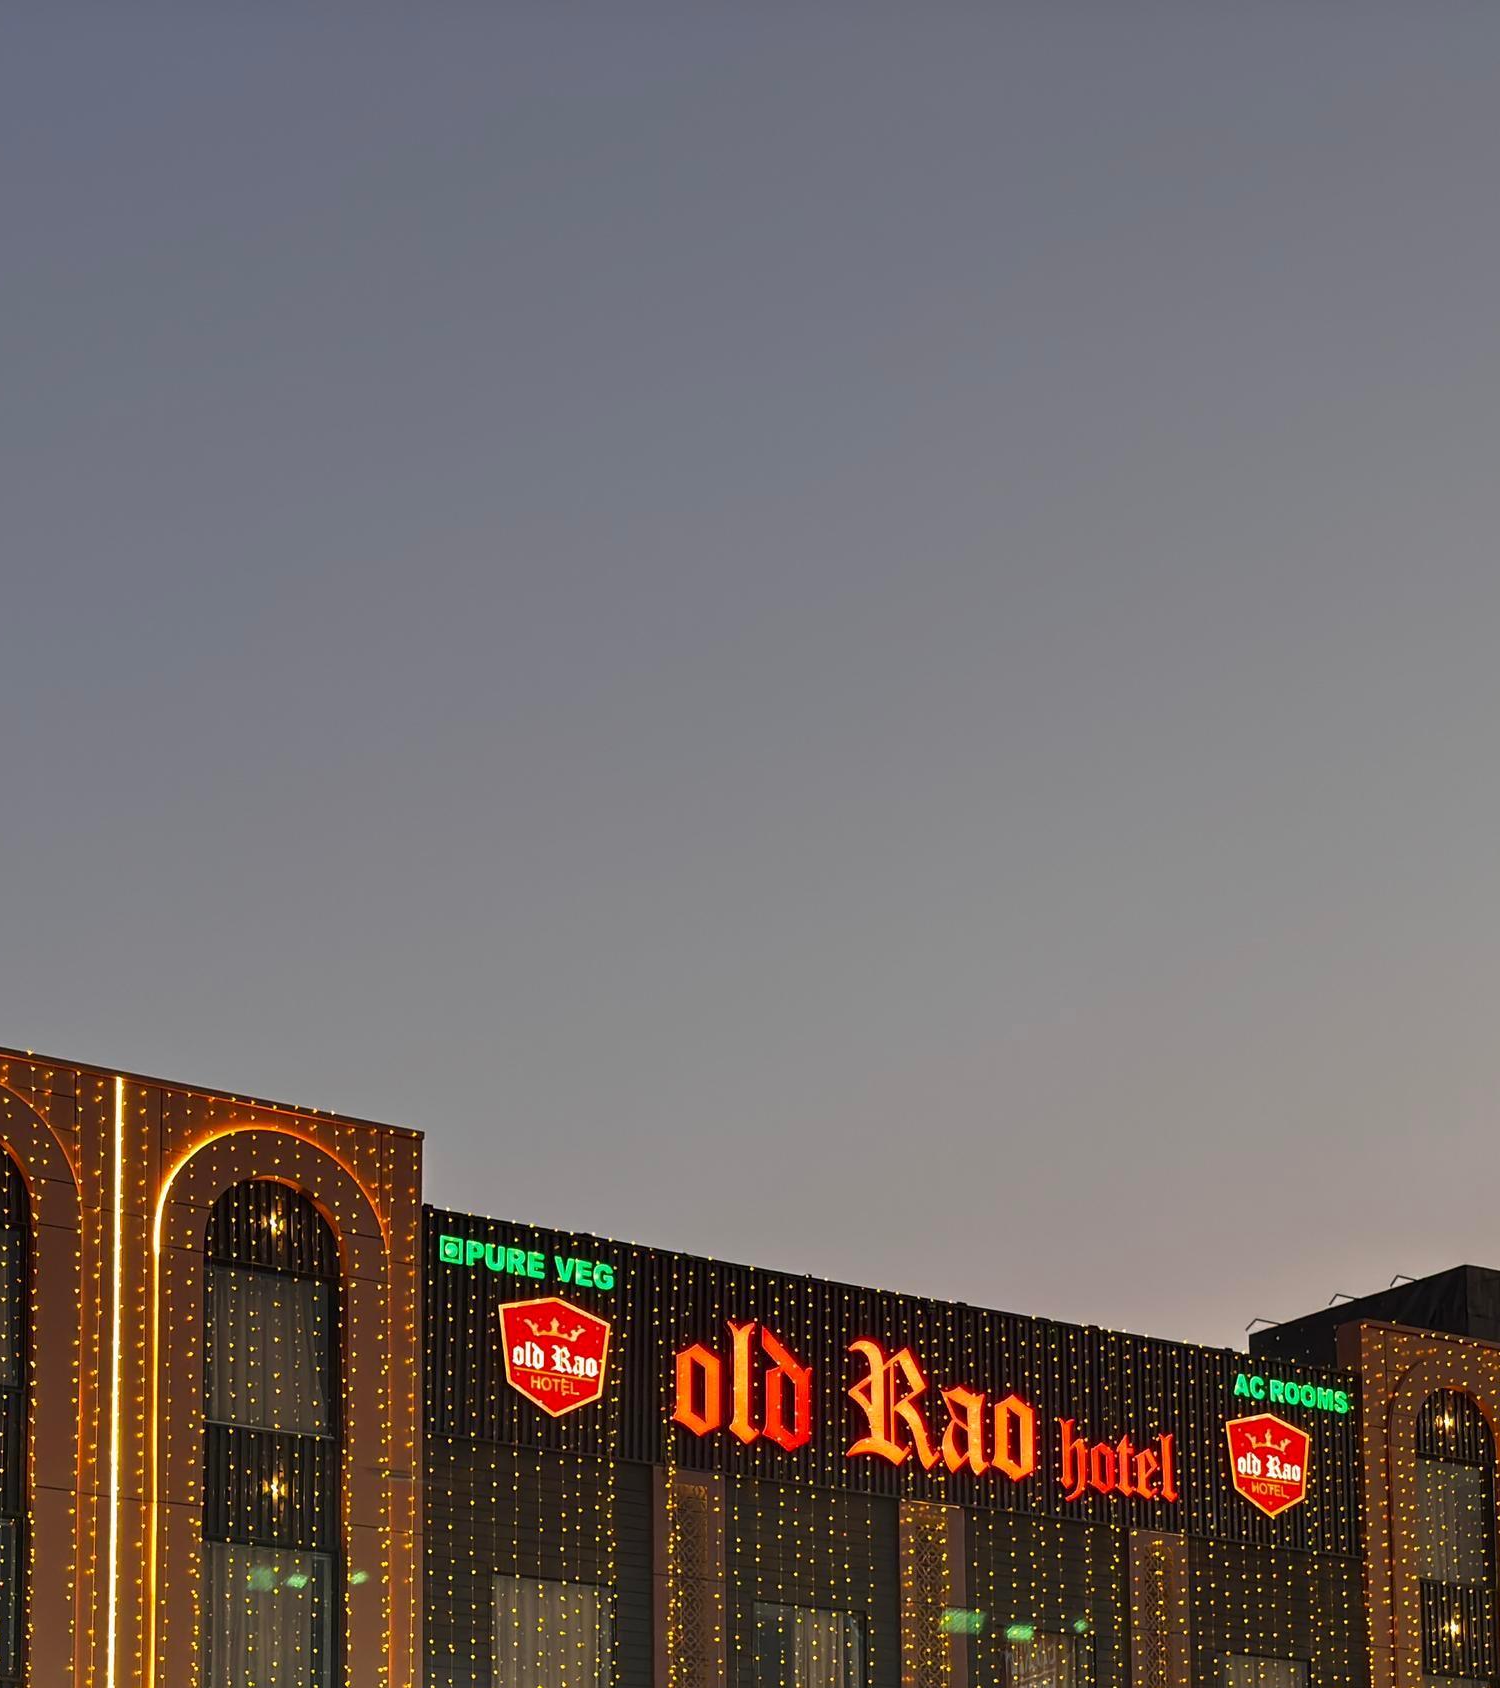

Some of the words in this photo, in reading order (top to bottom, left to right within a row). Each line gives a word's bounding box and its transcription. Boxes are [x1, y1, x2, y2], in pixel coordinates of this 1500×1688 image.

[466, 1240, 545, 1280] PURE
[554, 1256, 614, 1290] VEG
[512, 1341, 544, 1369] old
[551, 1345, 599, 1378] Rao
[530, 1375, 580, 1396] HOTEL
[1234, 1373, 1265, 1400] AC
[1269, 1379, 1349, 1414] ROOMS
[673, 1320, 813, 1451] old
[846, 1340, 1035, 1482] Rao
[1058, 1418, 1179, 1502] hotel
[1237, 1452, 1262, 1476] old
[1266, 1454, 1301, 1482] Rao
[1251, 1481, 1290, 1499] HOTEL
